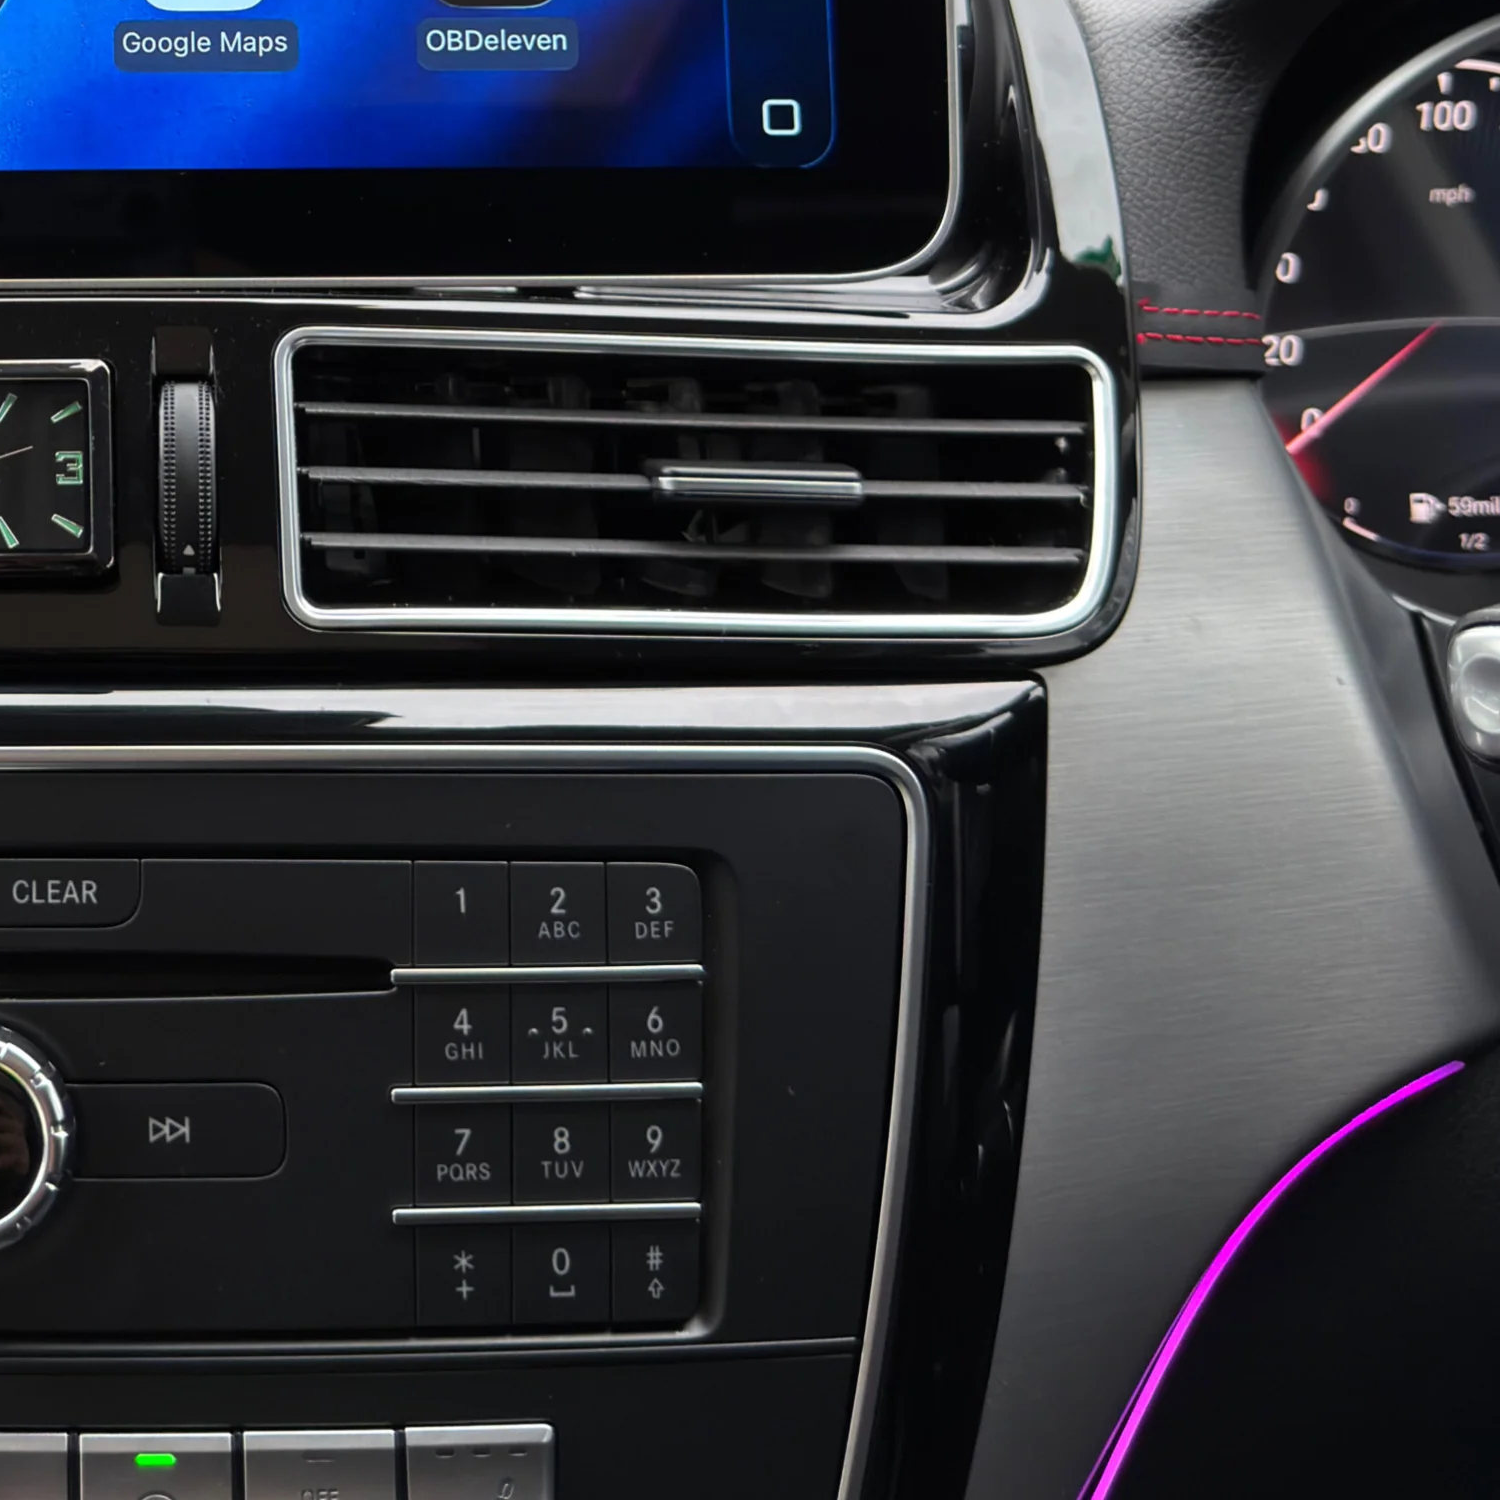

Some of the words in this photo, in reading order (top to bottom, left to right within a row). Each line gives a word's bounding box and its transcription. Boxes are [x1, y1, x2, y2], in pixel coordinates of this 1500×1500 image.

[122, 30, 212, 58] Google
[220, 31, 288, 57] Maps
[426, 28, 568, 52] OBDeleven
[1415, 100, 1476, 131] 100
[1428, 184, 1473, 207] mph
[1261, 332, 1305, 367] 20
[54, 451, 85, 486] 3
[1459, 532, 1488, 551] 1/2
[12, 879, 98, 904] CLEAR
[455, 887, 466, 914] 1
[550, 886, 566, 915] 2
[645, 886, 662, 915] 3
[538, 920, 580, 939] ABC
[634, 920, 674, 940] DEF
[453, 1008, 472, 1036] 4
[551, 1006, 568, 1035] 5
[646, 1006, 664, 1034] 6
[444, 1042, 483, 1061] GHI
[542, 1040, 579, 1059] JKL
[630, 1038, 681, 1058] MNO
[454, 1128, 472, 1156] 7
[553, 1126, 571, 1155] 8
[646, 1125, 663, 1153] 9
[436, 1162, 491, 1182] PQRS
[541, 1160, 584, 1179] TUV
[627, 1158, 681, 1178] WXYZ
[551, 1247, 571, 1276] 0
